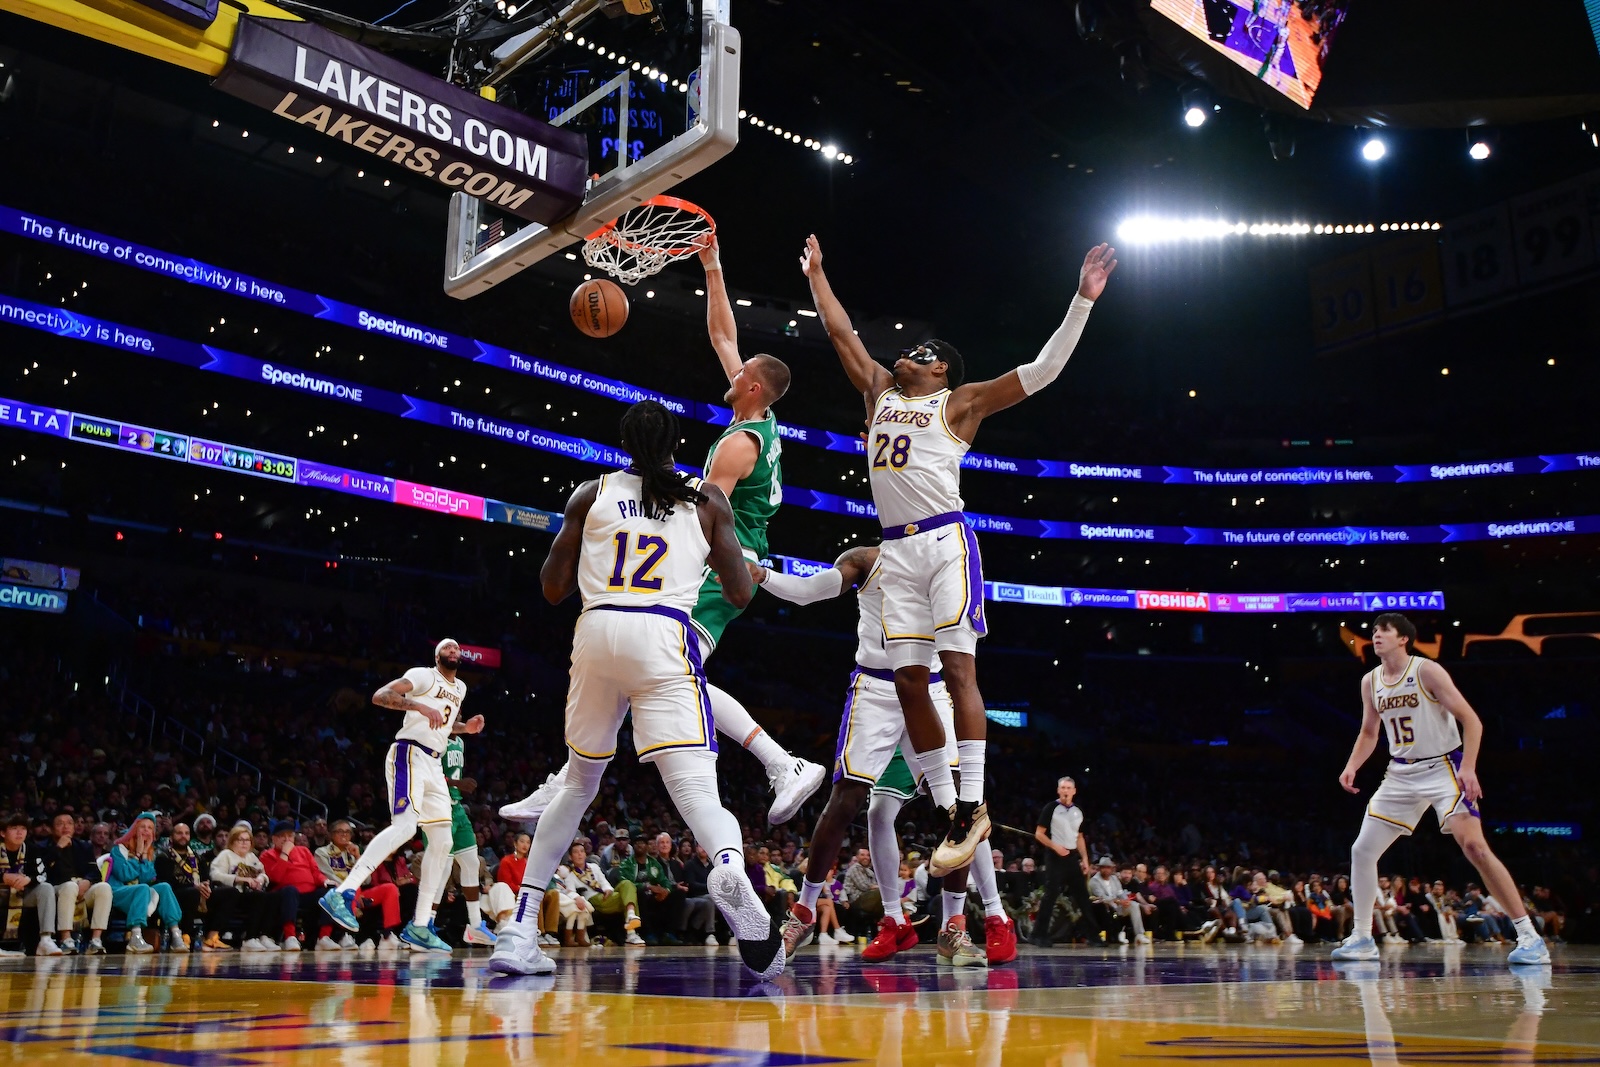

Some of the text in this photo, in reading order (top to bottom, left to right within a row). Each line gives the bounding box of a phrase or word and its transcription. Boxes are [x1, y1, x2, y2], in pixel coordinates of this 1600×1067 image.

[294, 45, 548, 181] LAKERS.COM
[272, 91, 535, 210] LAKERS.COM
[20, 216, 54, 238] The
[58, 227, 109, 254] future
[114, 245, 132, 259] of
[135, 252, 232, 289] connectivity
[235, 276, 247, 293] is
[588, 291, 601, 330] Wilson
[96, 324, 110, 341] is
[509, 354, 532, 371] The
[533, 362, 568, 382] future
[569, 372, 583, 385] of
[584, 376, 648, 402] connectivity
[874, 406, 933, 428] LAKERS
[79, 422, 112, 438] FOULS
[451, 411, 475, 429] The
[477, 418, 514, 438] future
[517, 429, 531, 442] of
[532, 433, 601, 462] connectivity
[604, 448, 613, 462] is
[127, 432, 138, 446] 2
[160, 438, 171, 452] 2
[200, 446, 221, 462] 107
[231, 451, 253, 469] 119
[872, 433, 912, 472] 28
[1576, 455, 1600, 467] The
[263, 458, 294, 477] 3:03
[983, 456, 993, 468] is
[1193, 470, 1213, 482] The
[1215, 471, 1249, 482] future
[1250, 470, 1263, 482] of
[1264, 470, 1332, 483] connectivity
[1334, 469, 1344, 481] is
[351, 477, 390, 494] ULTRA
[411, 486, 469, 512] boldyn
[846, 500, 866, 515] The
[978, 518, 988, 529] is
[1223, 531, 1244, 543] The
[1246, 531, 1281, 543] future
[1282, 530, 1295, 542] of
[1297, 530, 1367, 543] connectivity
[1369, 529, 1379, 541] is
[606, 530, 669, 594] 12
[1000, 587, 1058, 601] UCLA Health
[1084, 592, 1129, 604] crypto.com
[1138, 592, 1206, 608] TOSHIBA
[1328, 598, 1360, 606] ULTRA
[1386, 595, 1438, 608] DELTA
[434, 686, 460, 708] LAKERS
[1377, 692, 1420, 713] LAKERS
[442, 705, 452, 728] 3
[1390, 715, 1415, 747] 15
